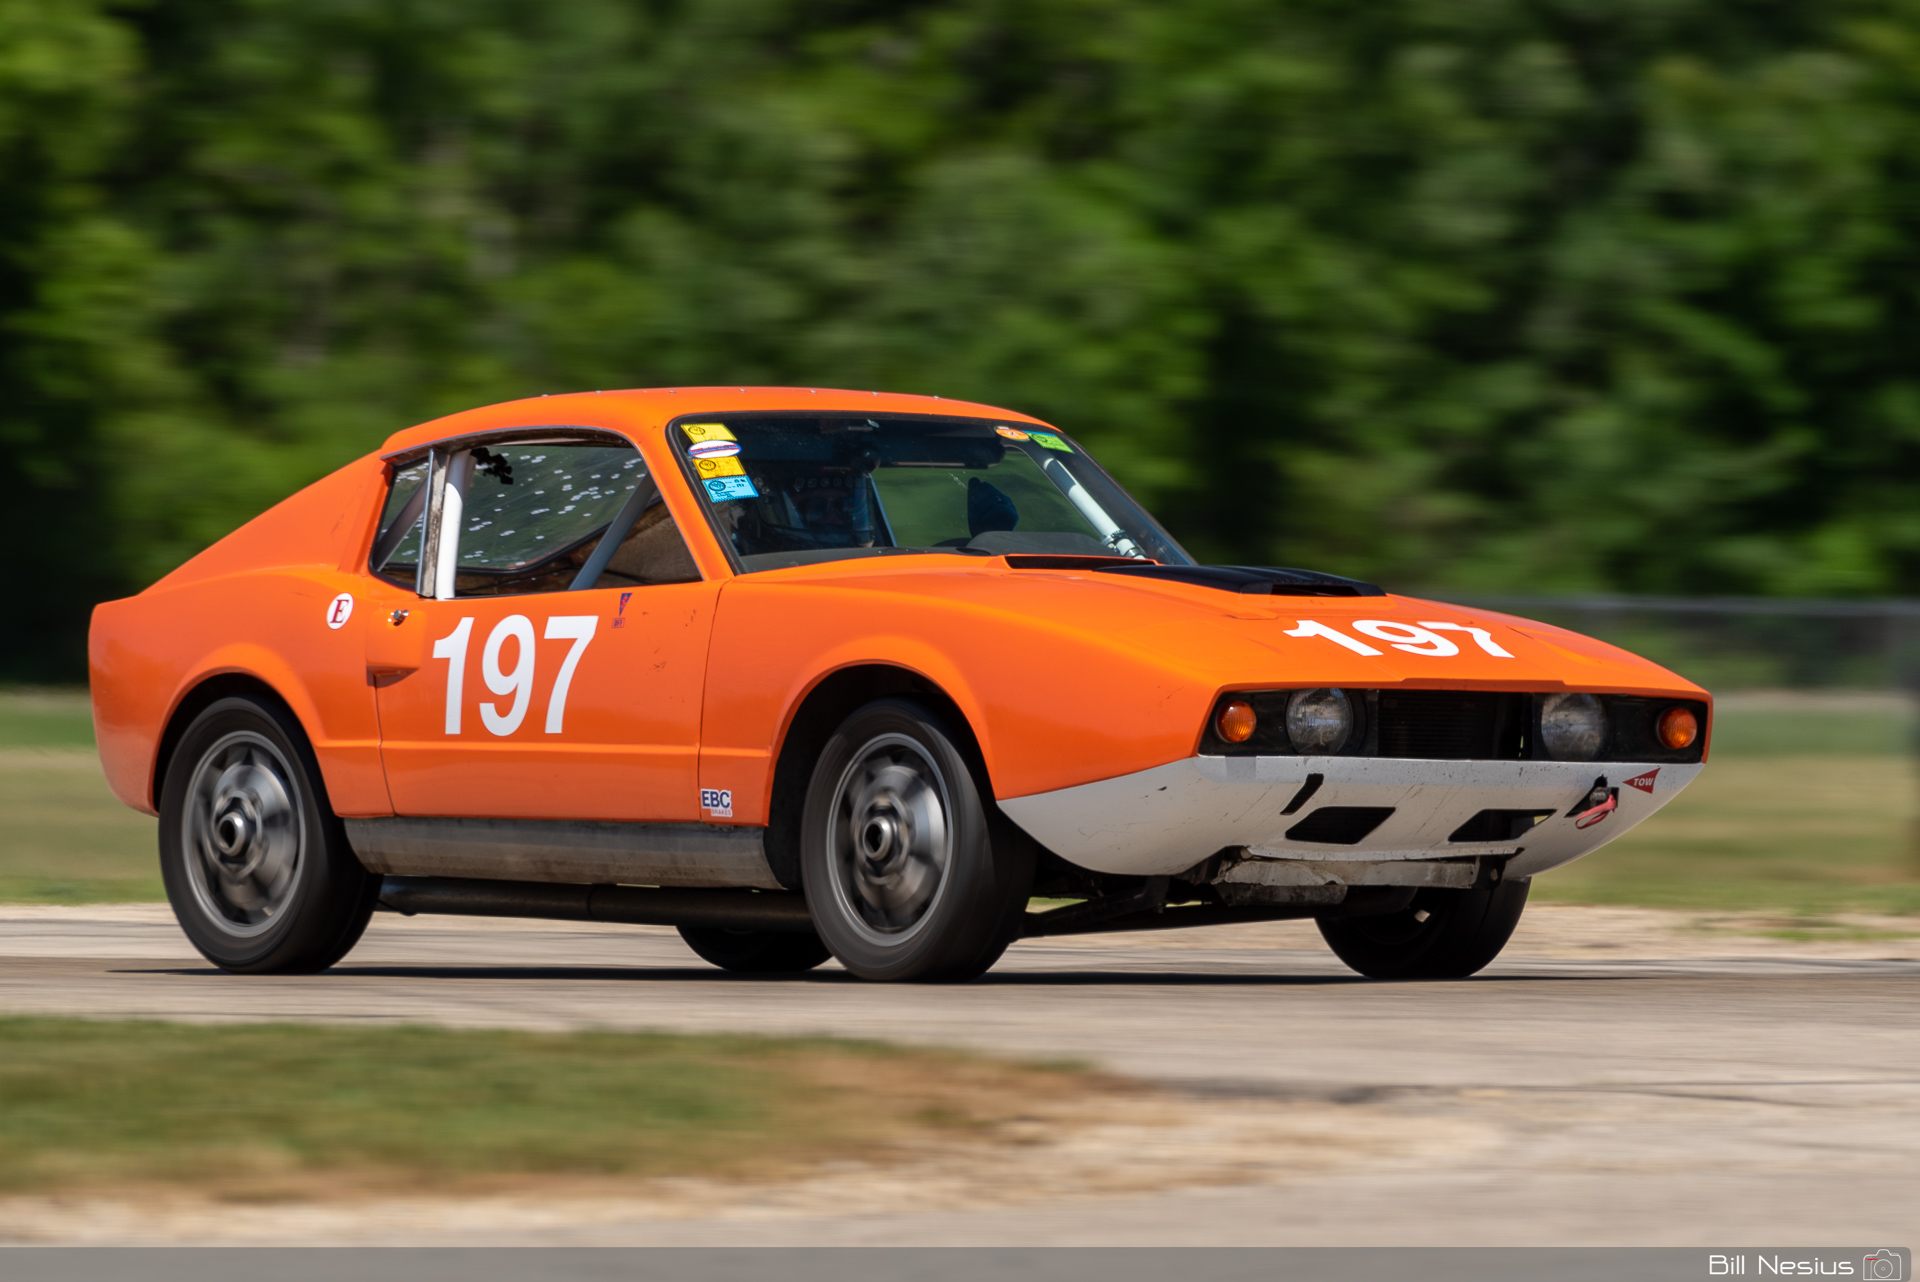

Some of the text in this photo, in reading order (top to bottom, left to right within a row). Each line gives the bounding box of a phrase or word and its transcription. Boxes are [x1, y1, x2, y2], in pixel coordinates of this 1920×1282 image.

[330, 600, 349, 623] E
[1283, 619, 1515, 658] 197
[432, 614, 599, 736] 197
[1633, 777, 1655, 787] TOW
[701, 790, 730, 808] EBC
